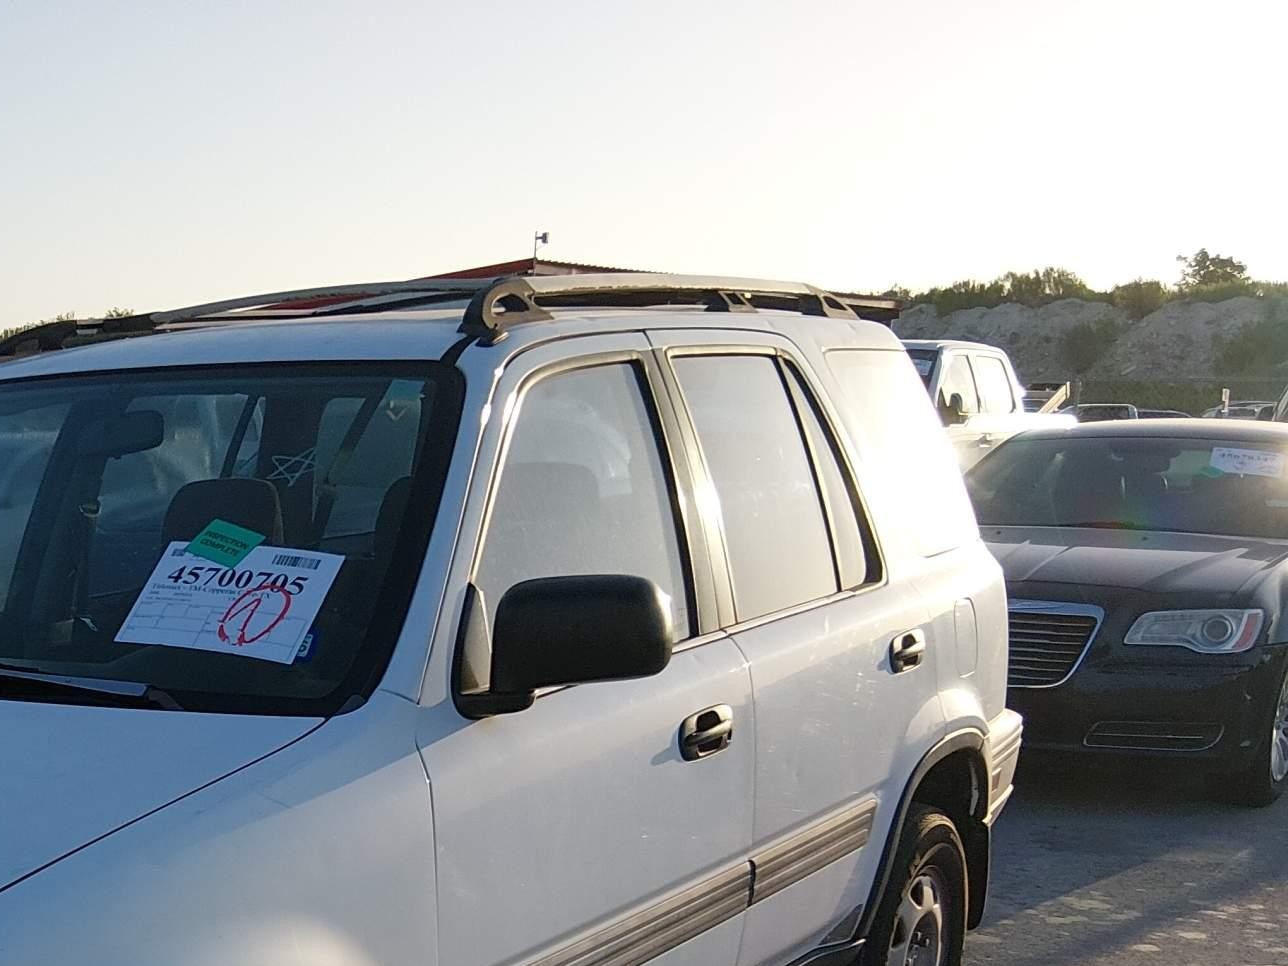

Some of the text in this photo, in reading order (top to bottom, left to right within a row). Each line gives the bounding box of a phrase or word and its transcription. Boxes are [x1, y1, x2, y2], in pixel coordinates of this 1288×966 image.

[199, 538, 240, 557] COMPLETE
[203, 530, 249, 550] INSPECTION
[168, 565, 309, 596] 45700705
